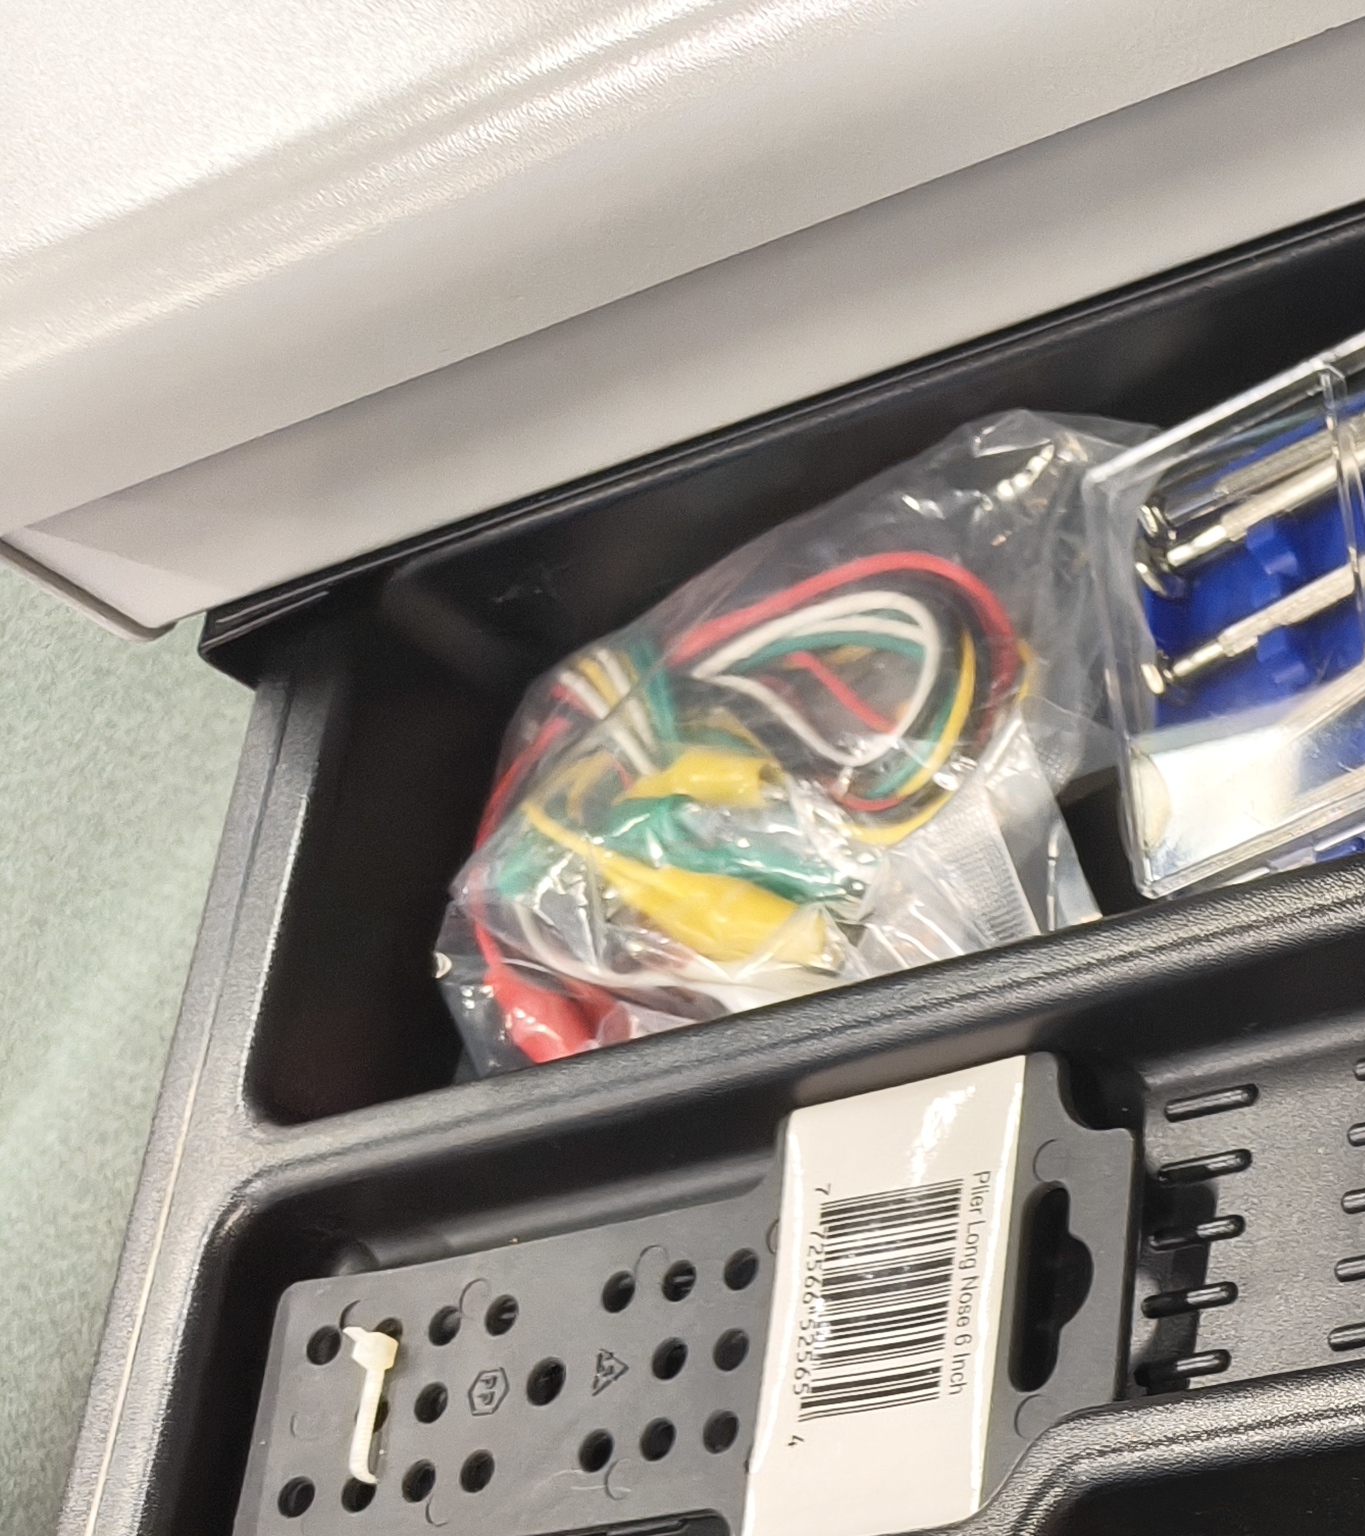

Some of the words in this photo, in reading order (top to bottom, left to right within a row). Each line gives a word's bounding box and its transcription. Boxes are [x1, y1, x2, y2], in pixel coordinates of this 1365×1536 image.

[967, 1169, 993, 1215] Plier
[957, 1219, 987, 1271] Long
[955, 1275, 981, 1328] Nose
[953, 1332, 973, 1348] 6
[948, 1352, 972, 1397] Inch
